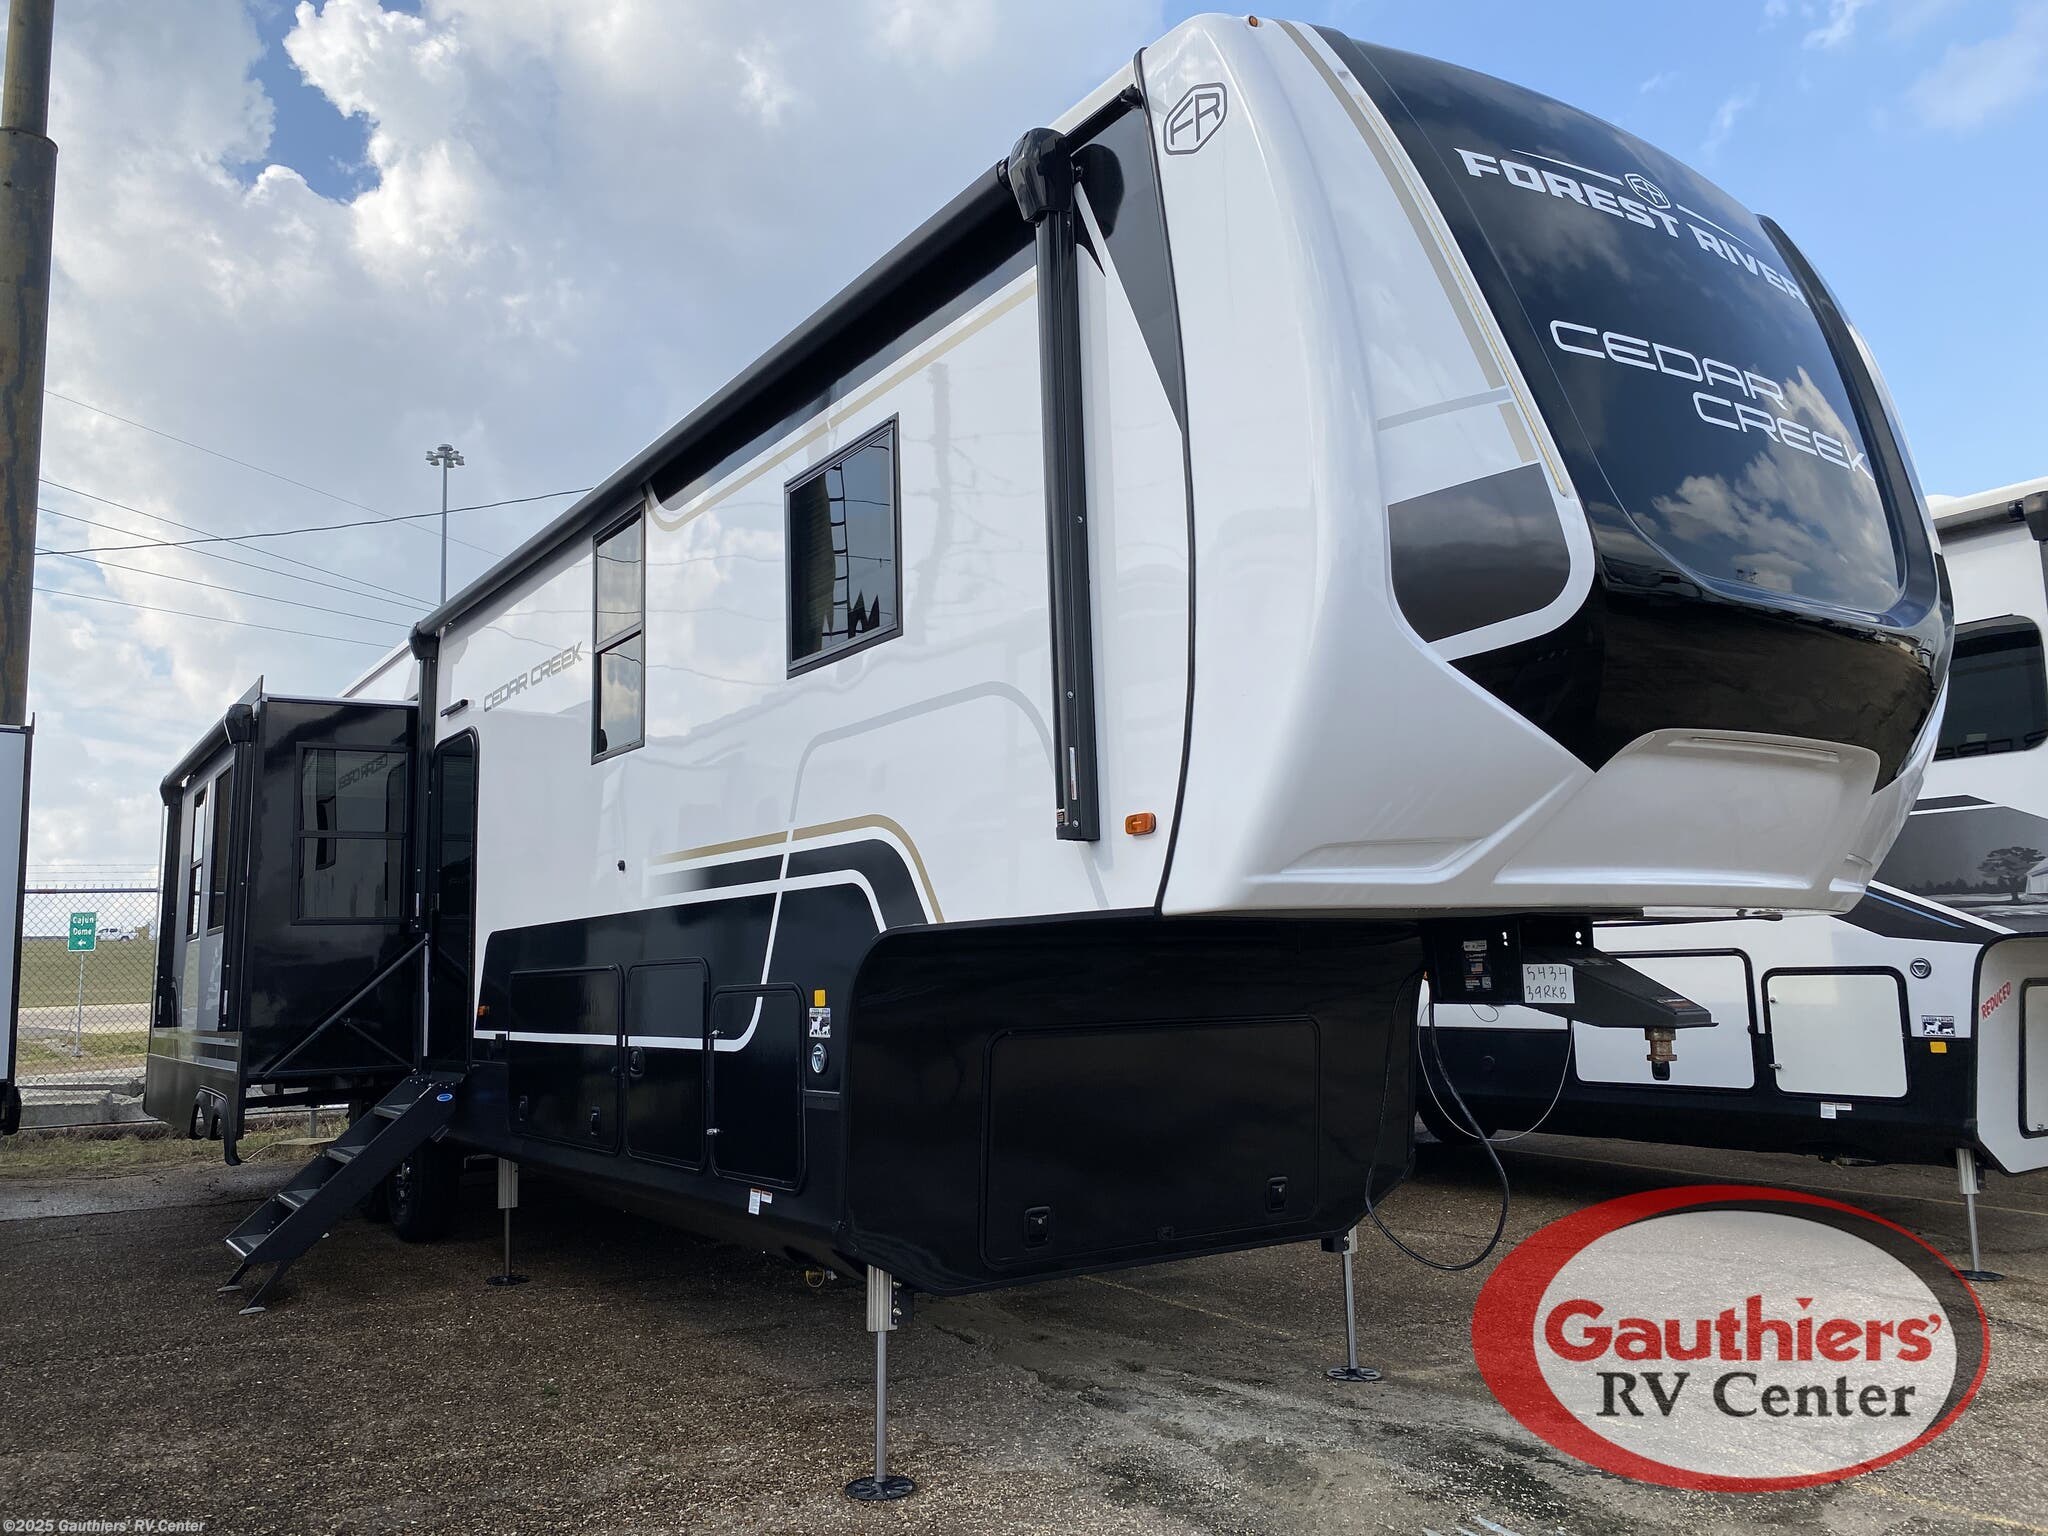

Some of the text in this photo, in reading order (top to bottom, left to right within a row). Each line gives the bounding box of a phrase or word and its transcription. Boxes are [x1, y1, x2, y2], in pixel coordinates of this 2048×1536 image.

[1454, 148, 1810, 309] FOREST RIVER
[1550, 319, 1787, 411] CEDAR
[1693, 391, 1875, 481] CREEK
[484, 640, 583, 712] CEDAR CREEK
[72, 916, 94, 926] Cajun
[72, 927, 92, 936] Dome
[1526, 985, 1568, 1001] 39RKB
[1527, 966, 1568, 982] 5434
[1981, 981, 2012, 1021] REDUCED
